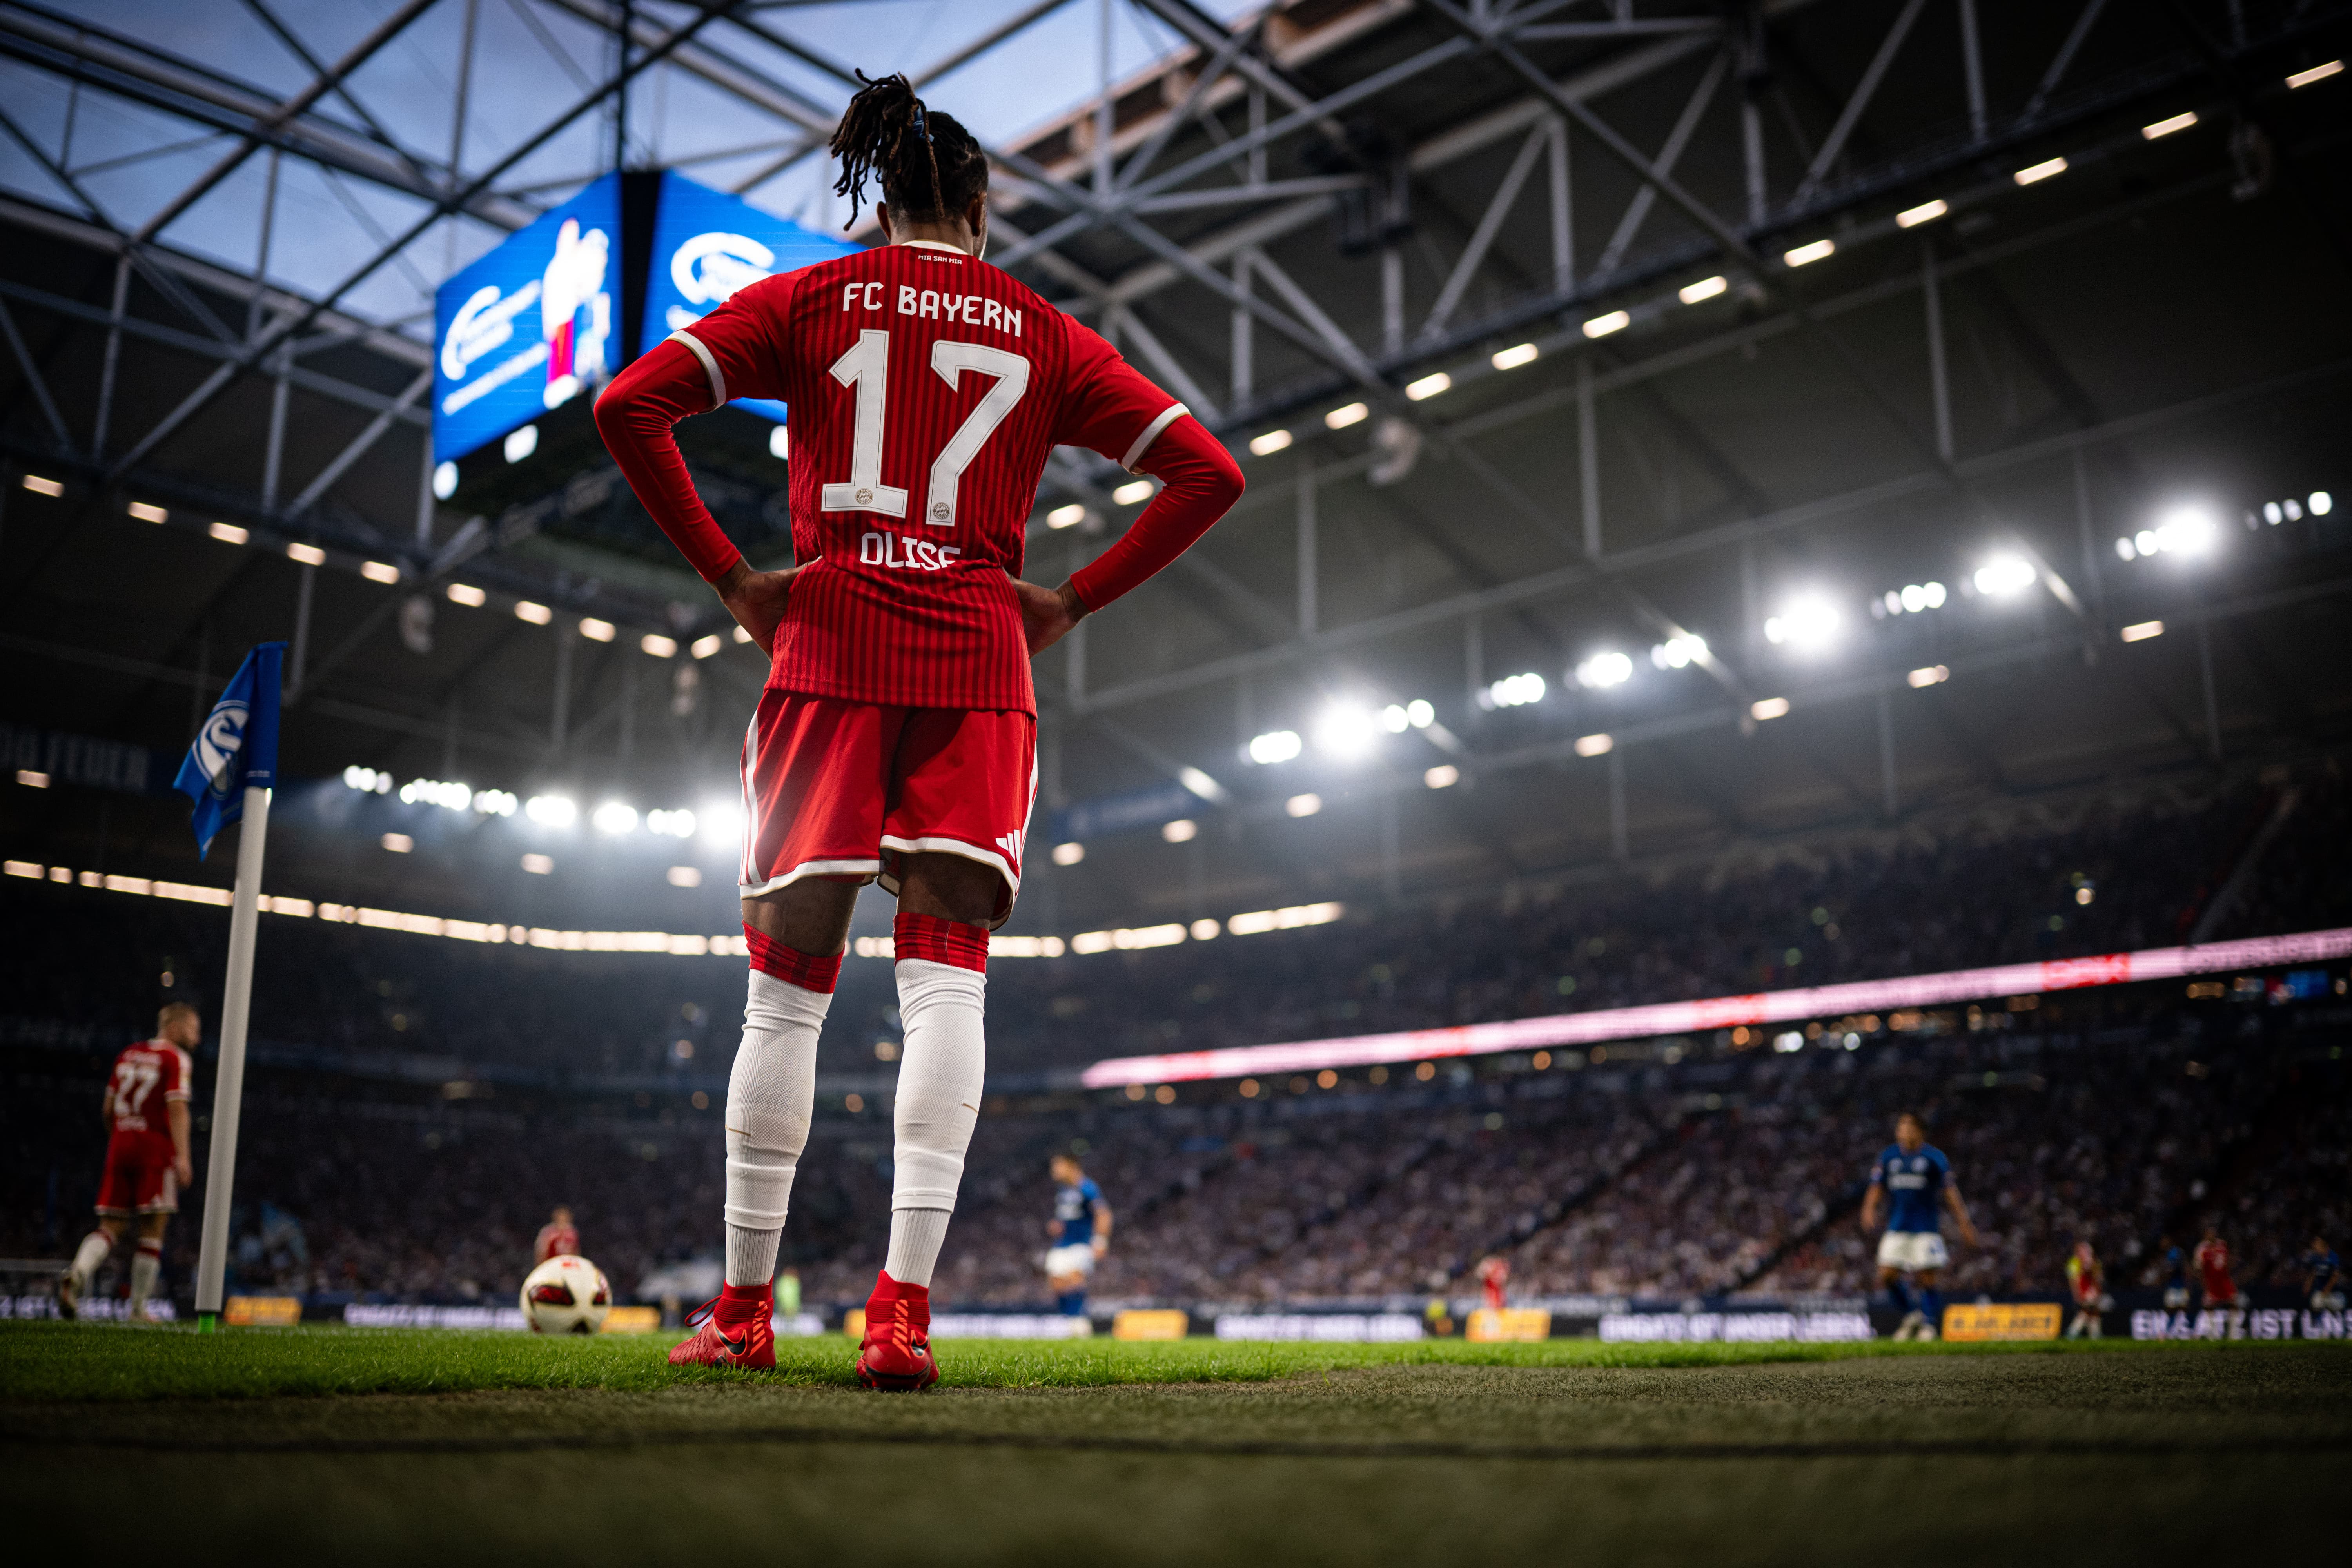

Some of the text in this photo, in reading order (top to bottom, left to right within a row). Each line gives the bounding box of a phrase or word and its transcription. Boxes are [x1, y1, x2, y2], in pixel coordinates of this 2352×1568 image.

[843, 282, 1022, 338] FC BAYERN
[821, 328, 1031, 527] 17
[114, 1062, 160, 1117] 27
[2249, 1308, 2296, 1340] IST
